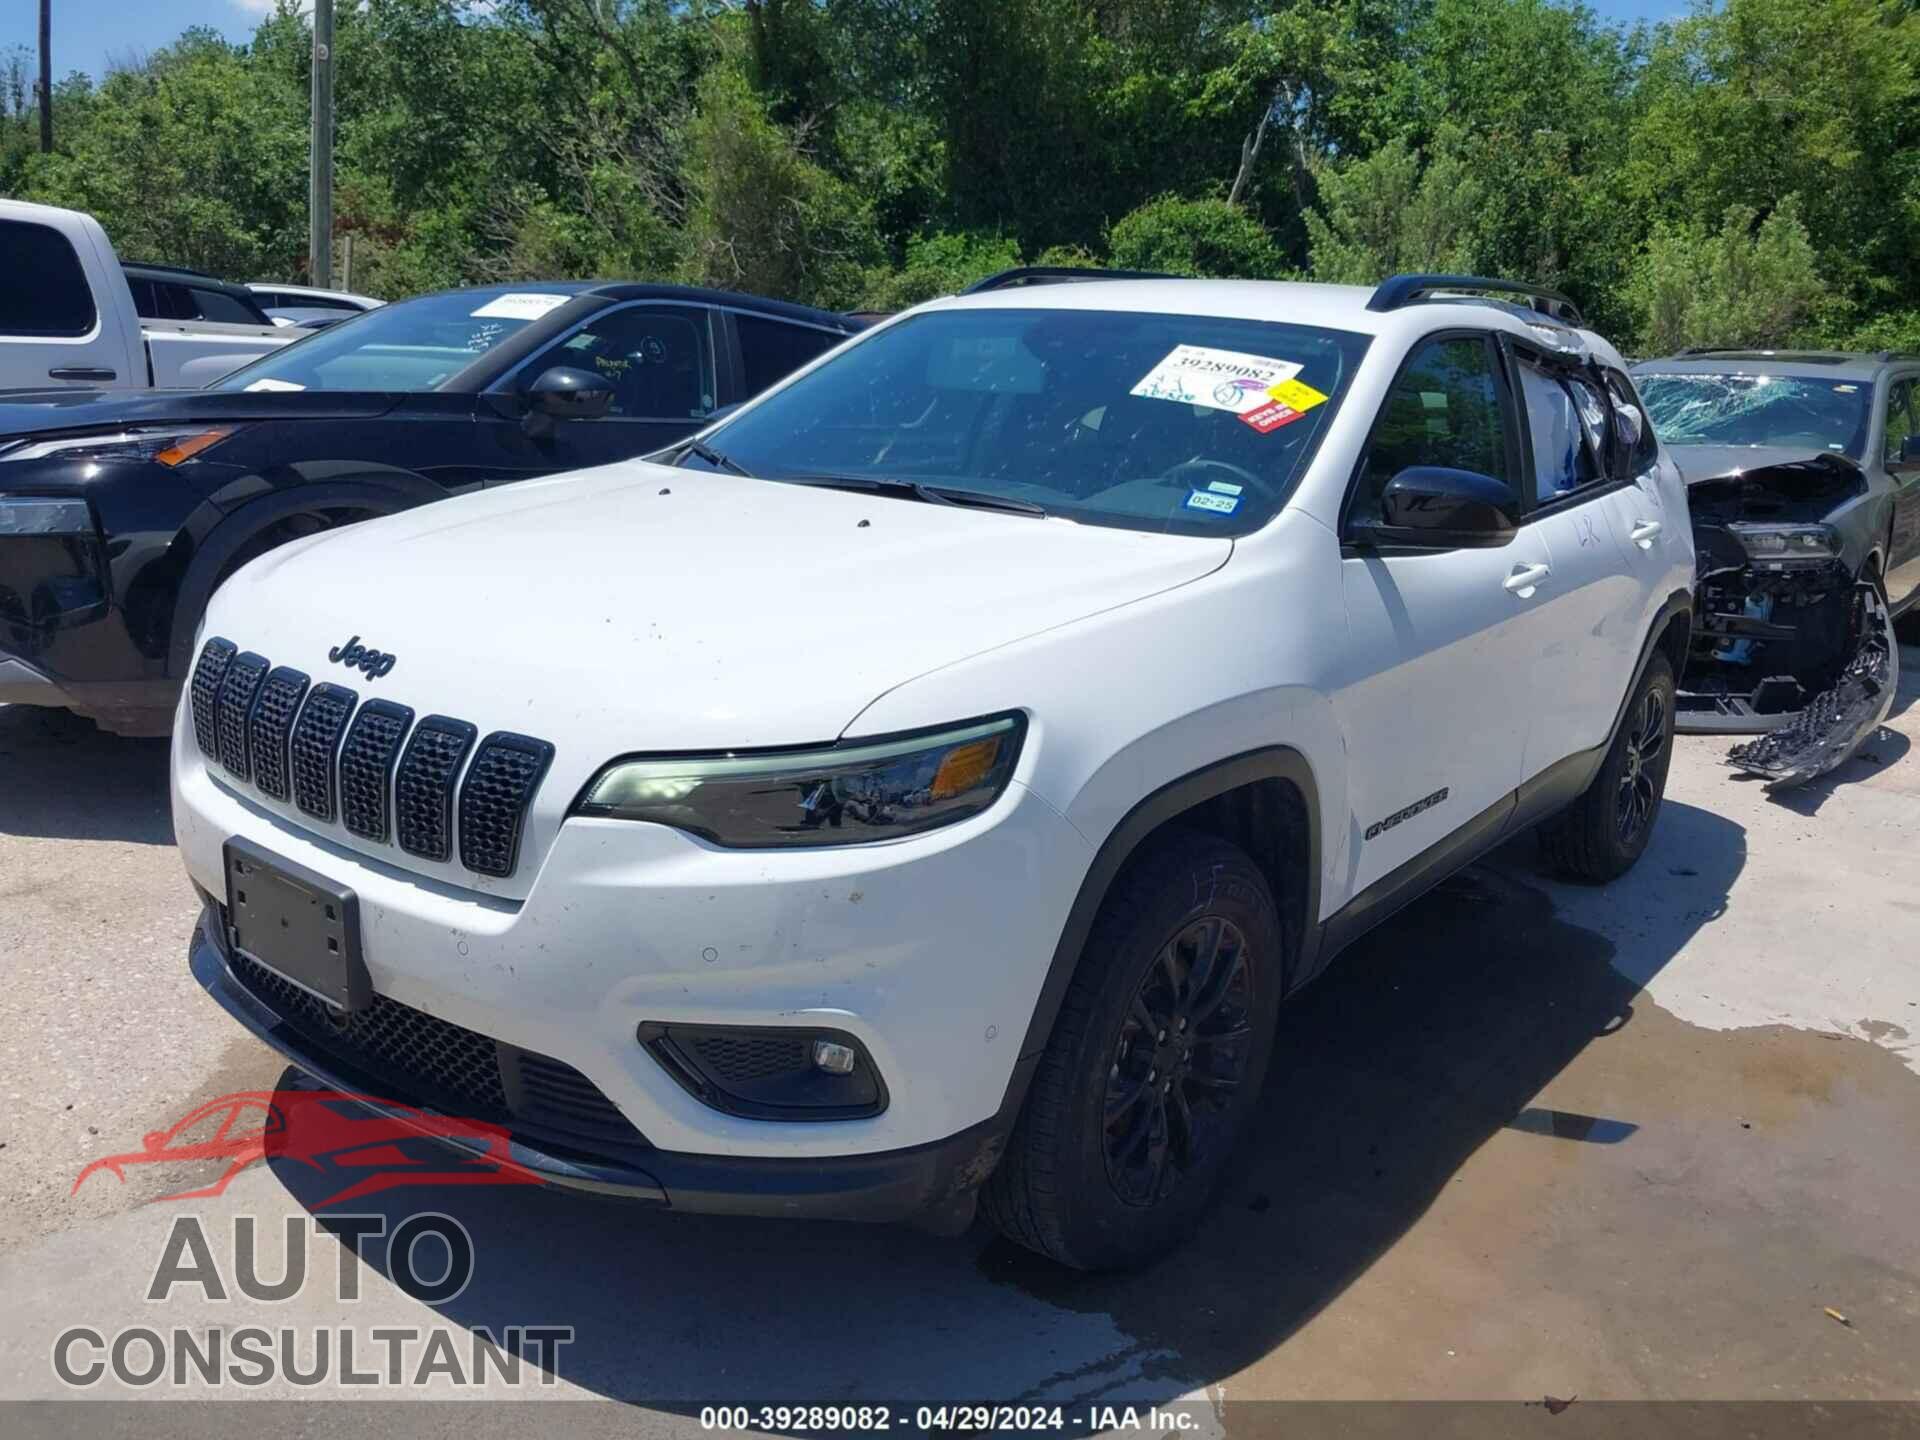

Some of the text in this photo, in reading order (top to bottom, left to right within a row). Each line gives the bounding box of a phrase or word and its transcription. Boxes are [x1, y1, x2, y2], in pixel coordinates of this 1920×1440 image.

[1173, 357, 1275, 383] 39289082
[328, 635, 397, 682] Jeep
[1364, 786, 1449, 841] CHEROKEE
